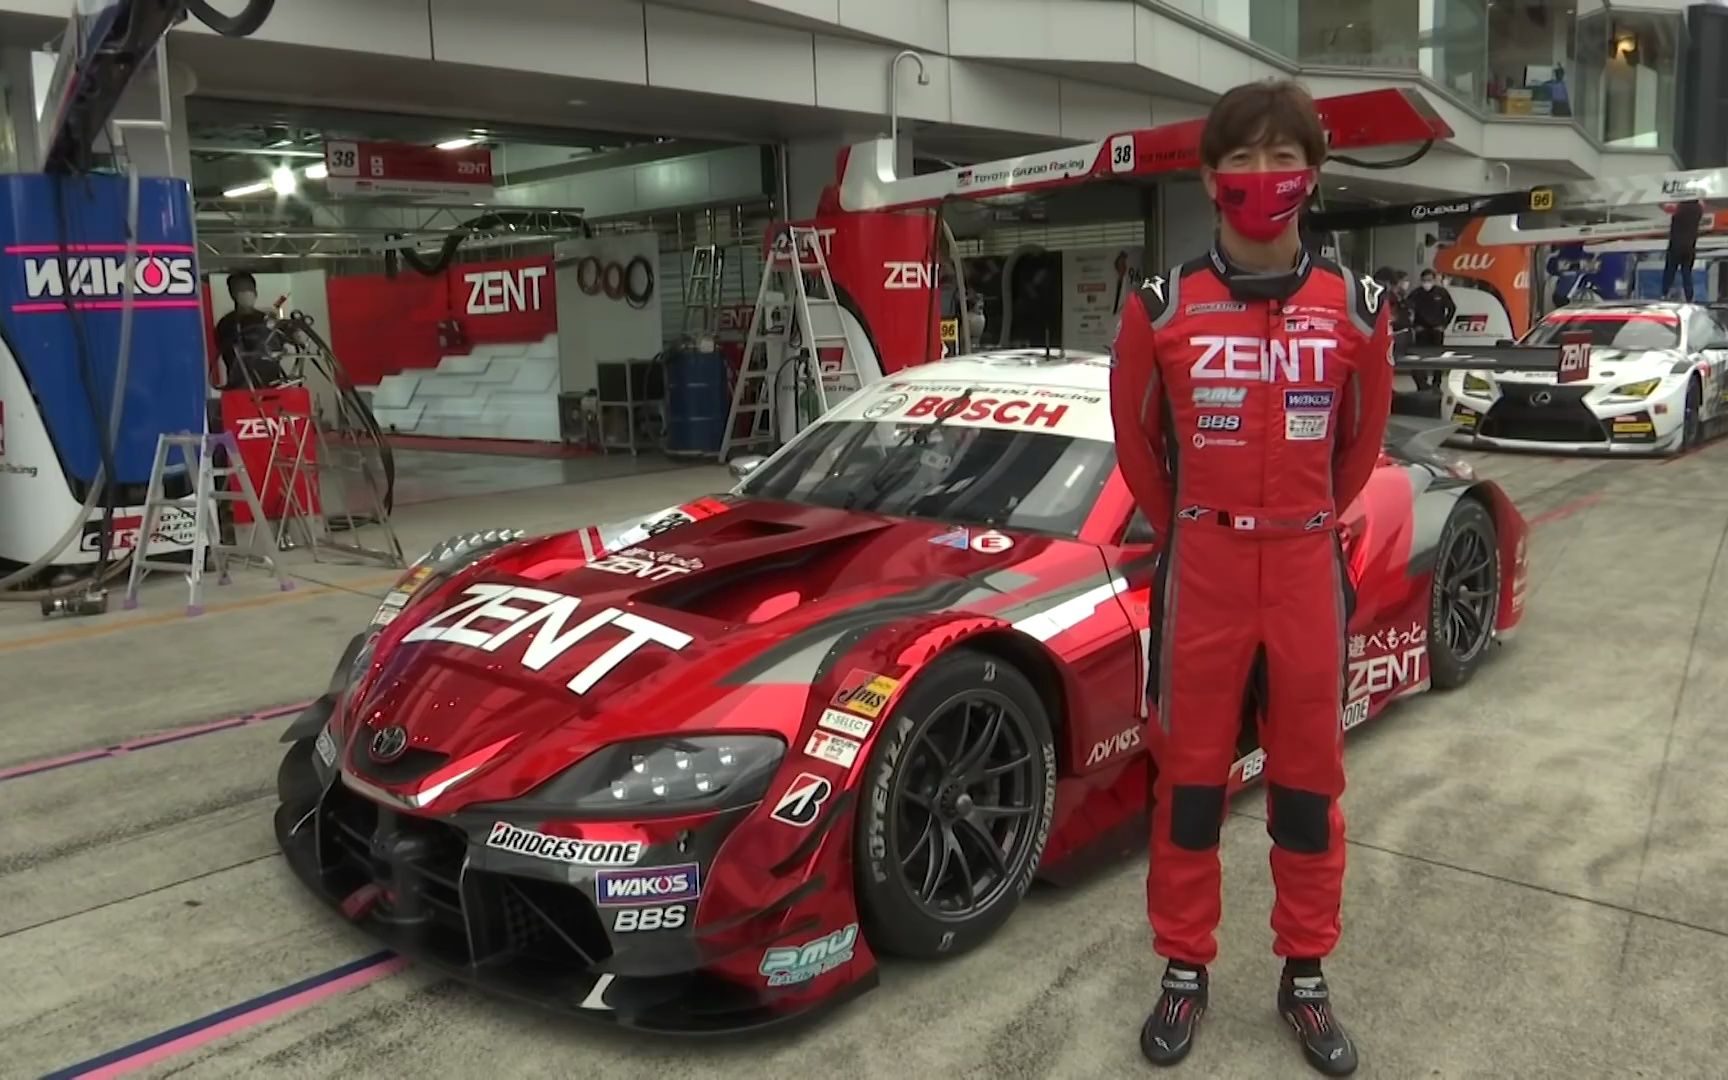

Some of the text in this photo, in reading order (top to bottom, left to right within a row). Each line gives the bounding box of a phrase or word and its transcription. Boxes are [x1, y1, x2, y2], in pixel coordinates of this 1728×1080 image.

[332, 151, 356, 168] 38
[1114, 145, 1131, 164] 38
[457, 162, 487, 174] ZENT
[1049, 159, 1085, 173] Racing
[1275, 175, 1302, 194] ZENT
[1426, 202, 1469, 215] LEXUS
[1533, 192, 1550, 208] 96
[1453, 252, 1496, 271] au
[464, 266, 547, 315] ZENT
[942, 324, 955, 337] 96
[1189, 335, 1338, 383] ZENT
[1560, 343, 1591, 373] ZENT
[904, 395, 1069, 428] BOSCH
[236, 416, 301, 440] ZENT
[1197, 415, 1241, 430] BBS
[585, 554, 693, 581] ZENT
[401, 584, 694, 695] ZENT
[1347, 645, 1428, 702] ZENT
[490, 825, 641, 864] BRIDGESTONE
[613, 905, 687, 932] BBS
